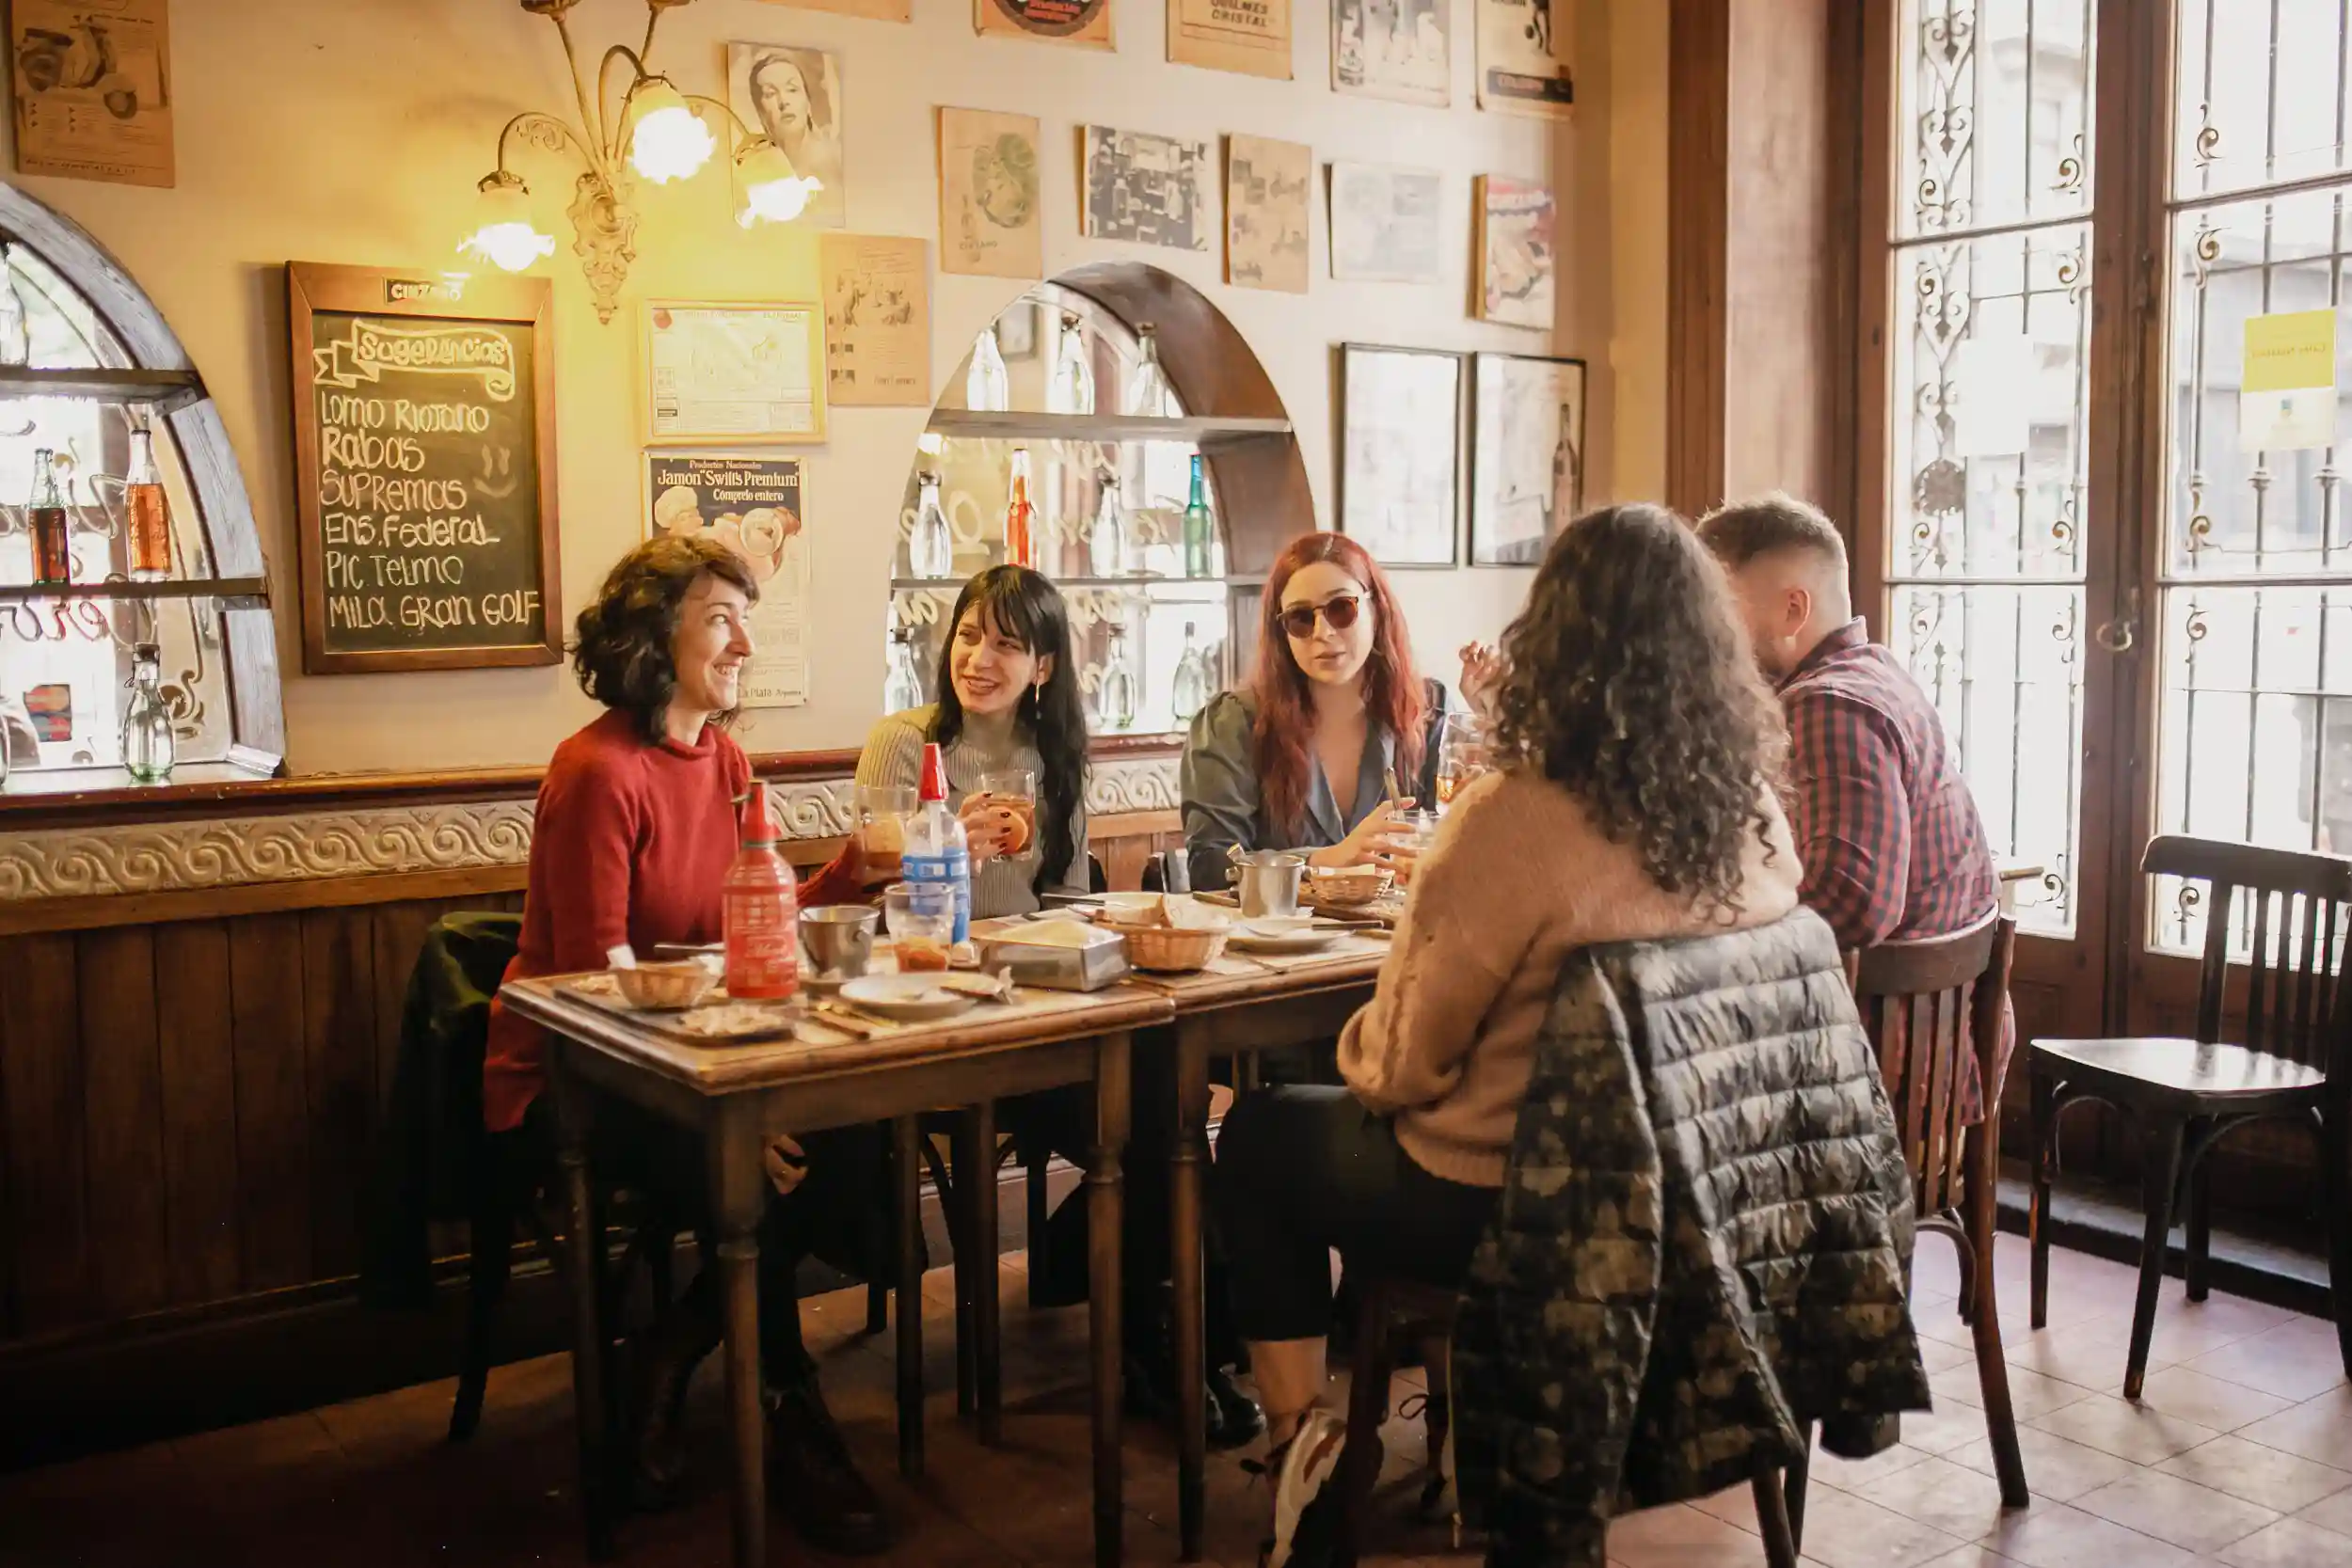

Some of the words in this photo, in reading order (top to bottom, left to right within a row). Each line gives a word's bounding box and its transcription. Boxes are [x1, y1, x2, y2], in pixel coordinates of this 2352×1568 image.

[322, 426, 425, 472] Rabas
[755, 491, 785, 502] entero
[482, 589, 541, 625] GOLF
